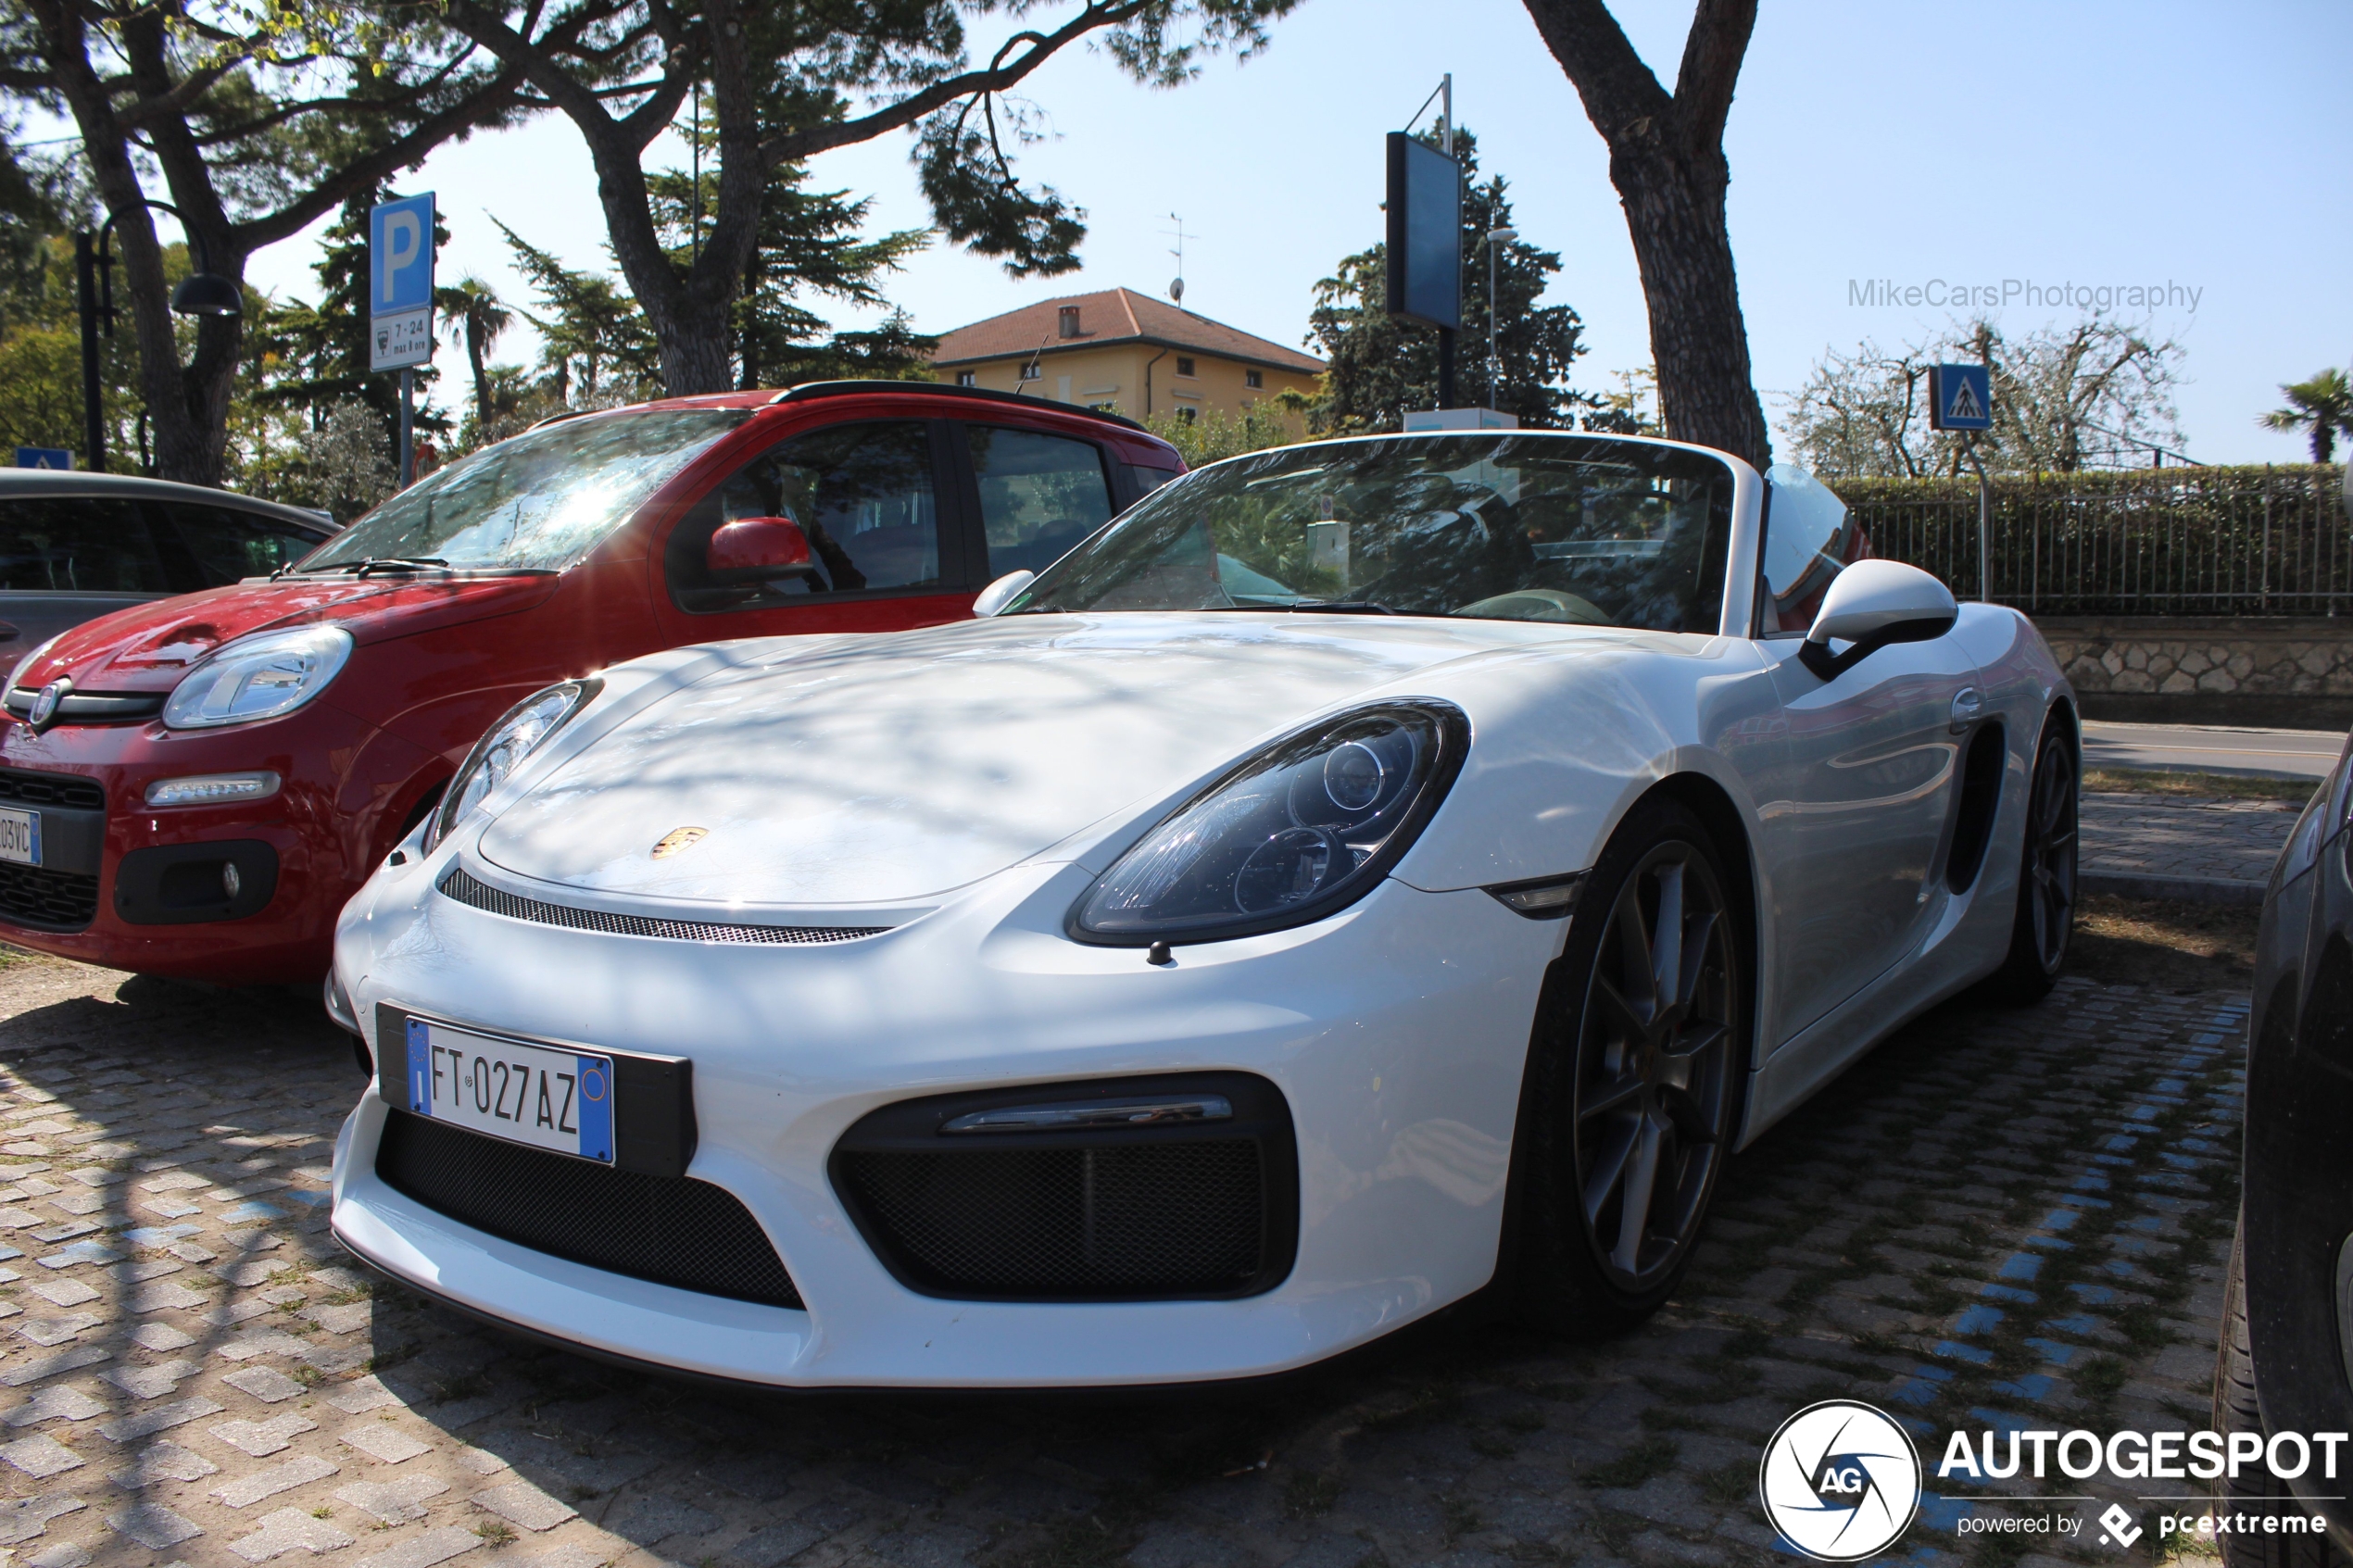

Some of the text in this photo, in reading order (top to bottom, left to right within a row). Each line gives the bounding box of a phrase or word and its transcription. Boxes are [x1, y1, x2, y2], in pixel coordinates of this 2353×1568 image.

[384, 210, 421, 302] P
[396, 323, 401, 338] 7
[409, 319, 423, 335] 24
[394, 344, 407, 355] max
[415, 341, 425, 351] ore
[0, 818, 30, 853] 03VC
